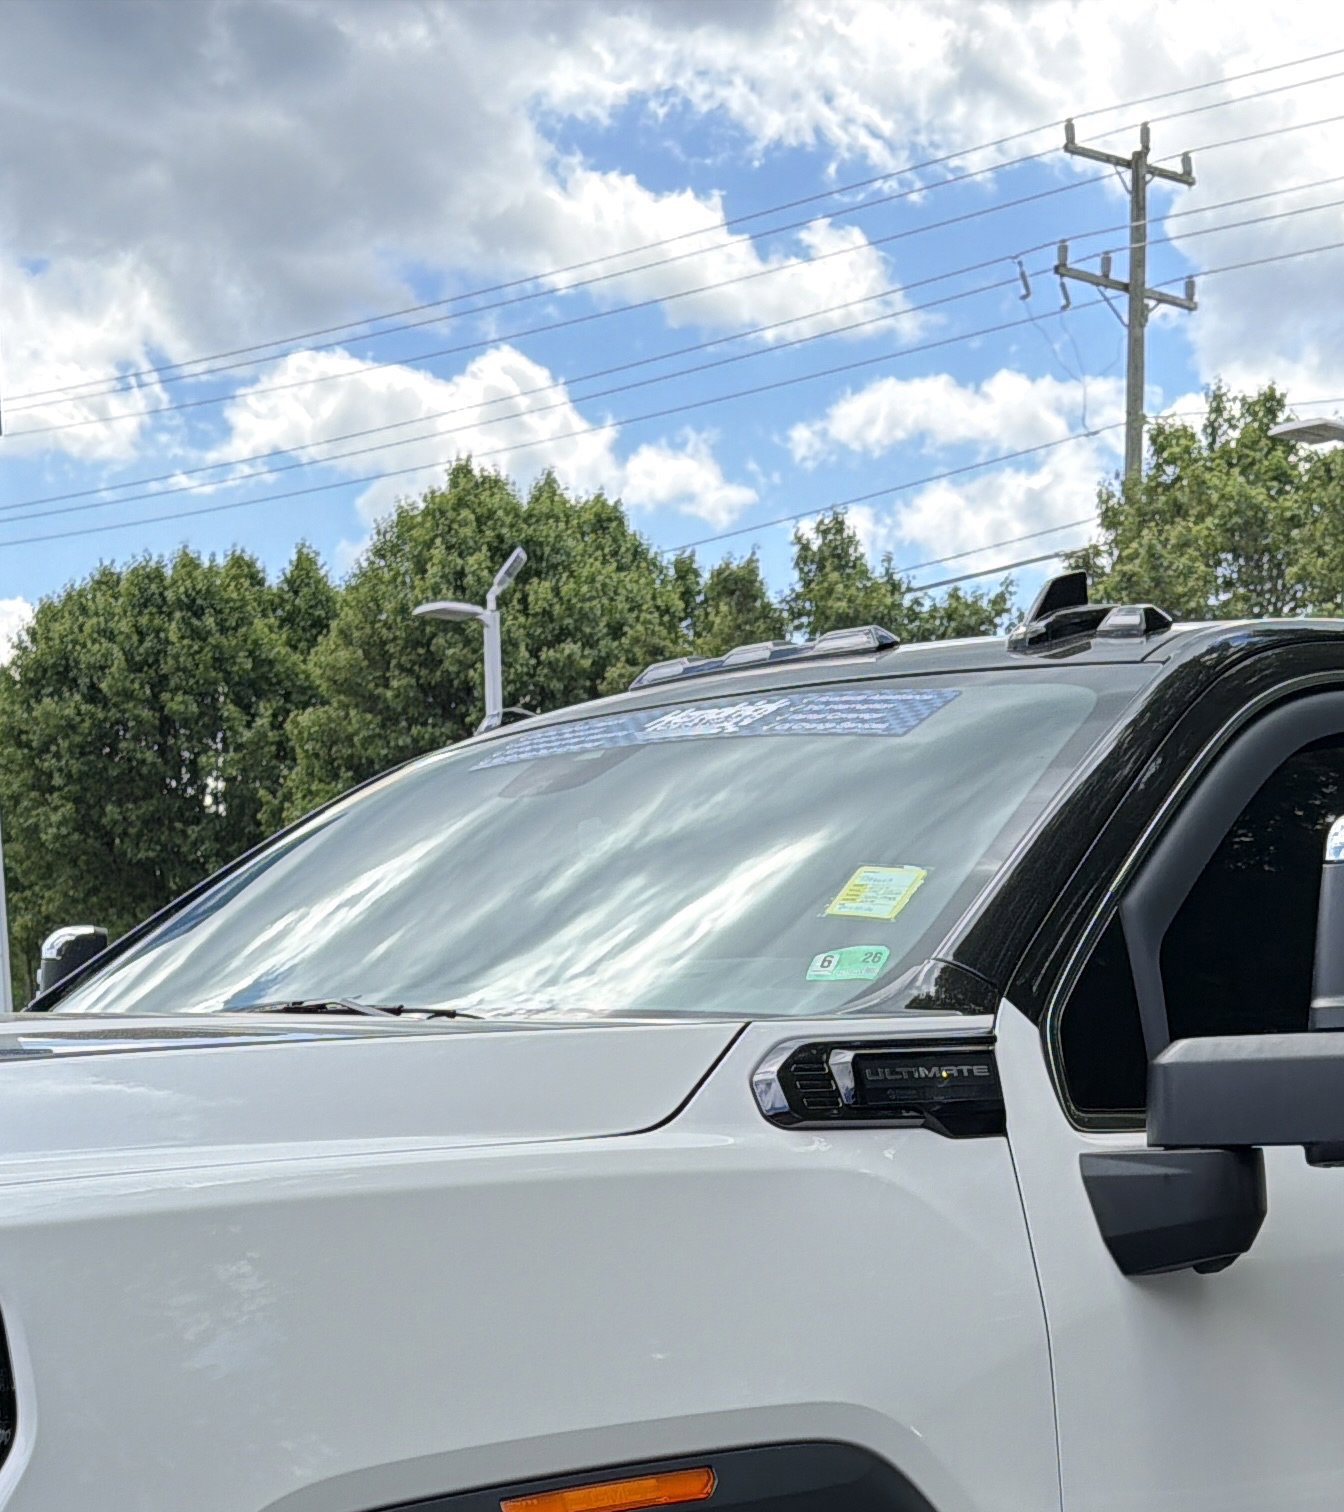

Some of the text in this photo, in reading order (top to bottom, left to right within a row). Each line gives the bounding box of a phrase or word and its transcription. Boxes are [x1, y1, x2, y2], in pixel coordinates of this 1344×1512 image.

[819, 954, 835, 969] 6
[862, 951, 884, 964] 26
[865, 1064, 991, 1081] ULTIMATE
